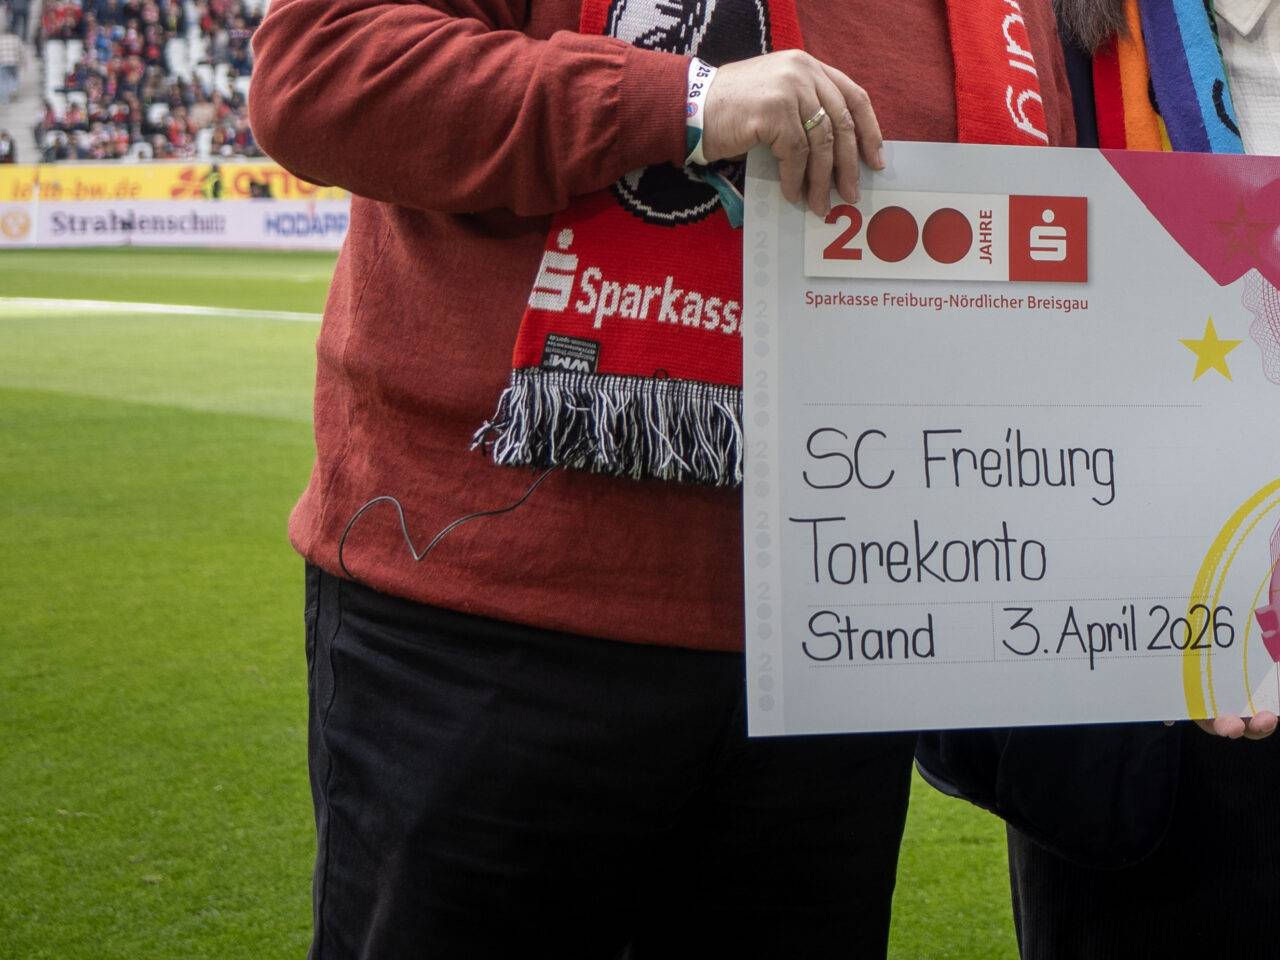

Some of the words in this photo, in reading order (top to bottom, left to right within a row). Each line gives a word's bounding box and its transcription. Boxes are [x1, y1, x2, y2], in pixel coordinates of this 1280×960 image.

[979, 209, 993, 265] JAHRE
[805, 291, 879, 308] Sparkasse
[883, 293, 1023, 311] Freiburg-Nördlicher
[1027, 294, 1088, 313] Breisgau
[803, 427, 895, 489] SC
[923, 427, 1115, 506] Freiburg
[789, 516, 1047, 585] Torekonto
[802, 610, 935, 661] Stand
[1002, 607, 1048, 656] 3.
[1056, 604, 1137, 671] April
[1147, 604, 1235, 651] 2026
